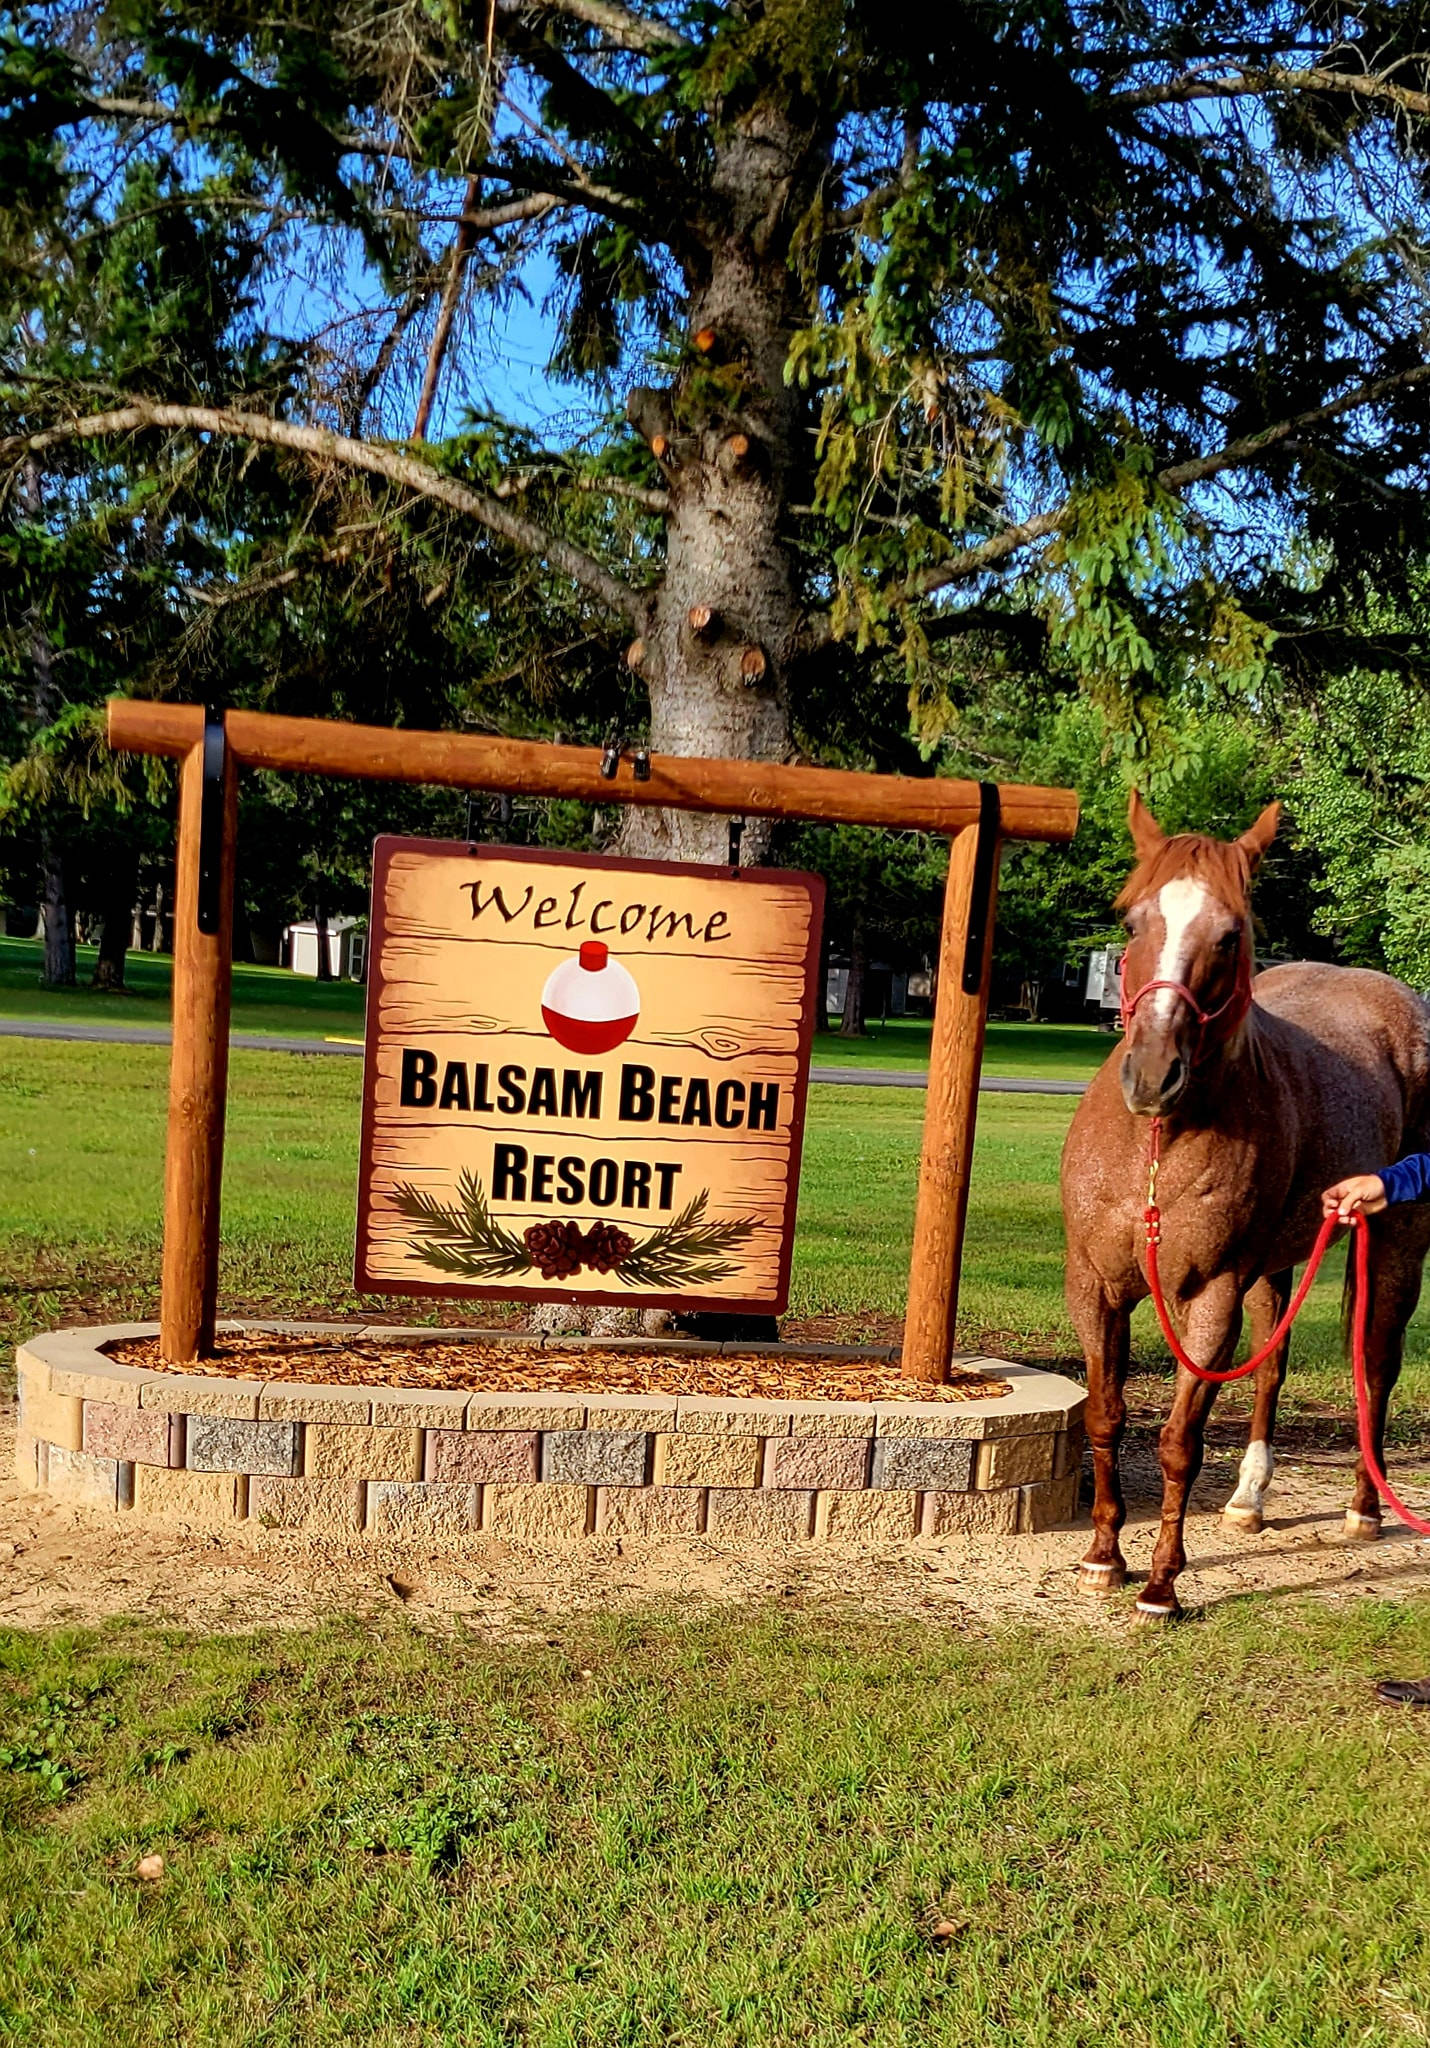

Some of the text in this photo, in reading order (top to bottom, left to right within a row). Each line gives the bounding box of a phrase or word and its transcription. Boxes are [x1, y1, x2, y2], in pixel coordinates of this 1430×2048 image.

[459, 880, 732, 943] Welcome
[400, 1048, 781, 1132] BALSAM BEACH
[491, 1142, 683, 1211] RESORT
